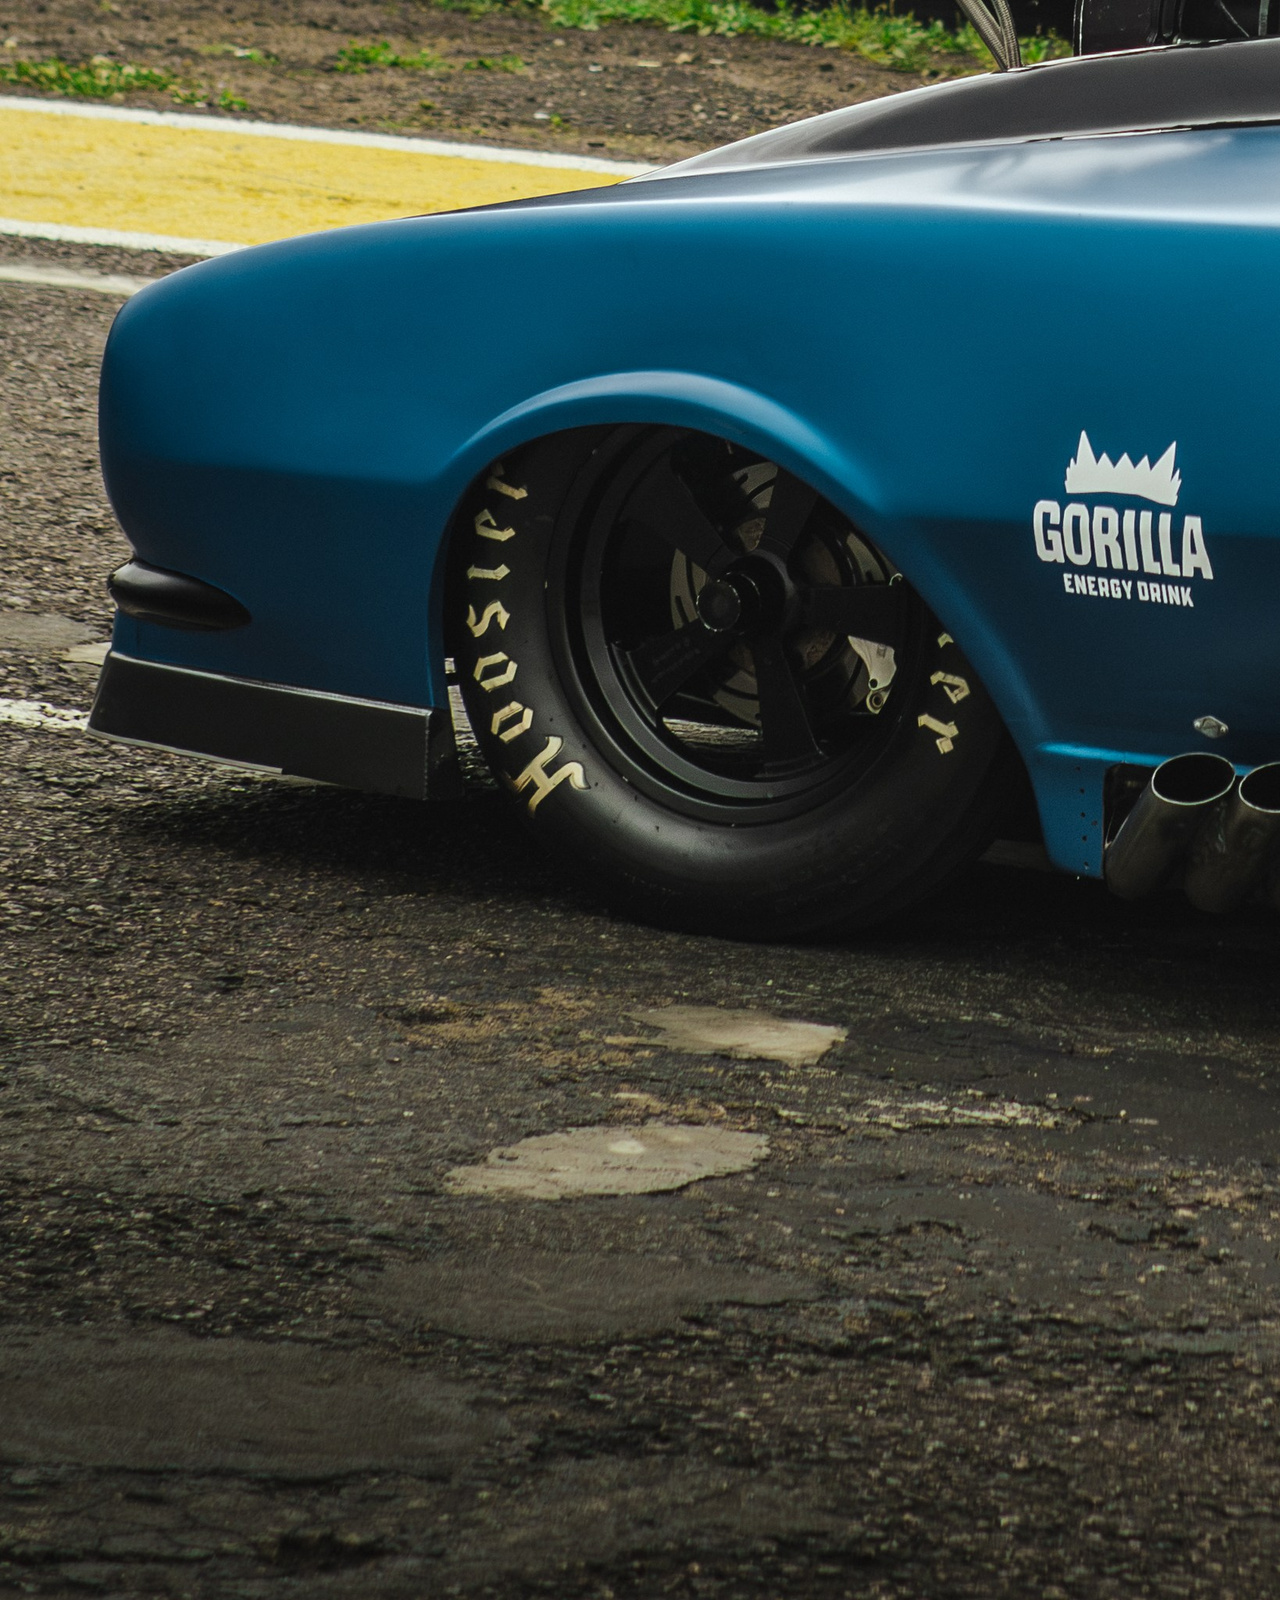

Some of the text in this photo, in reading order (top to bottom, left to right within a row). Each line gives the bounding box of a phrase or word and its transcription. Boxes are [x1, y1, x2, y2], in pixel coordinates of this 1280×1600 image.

[1033, 499, 1214, 580] GORILLA
[1063, 573, 1195, 608] ENERGY DRINK
